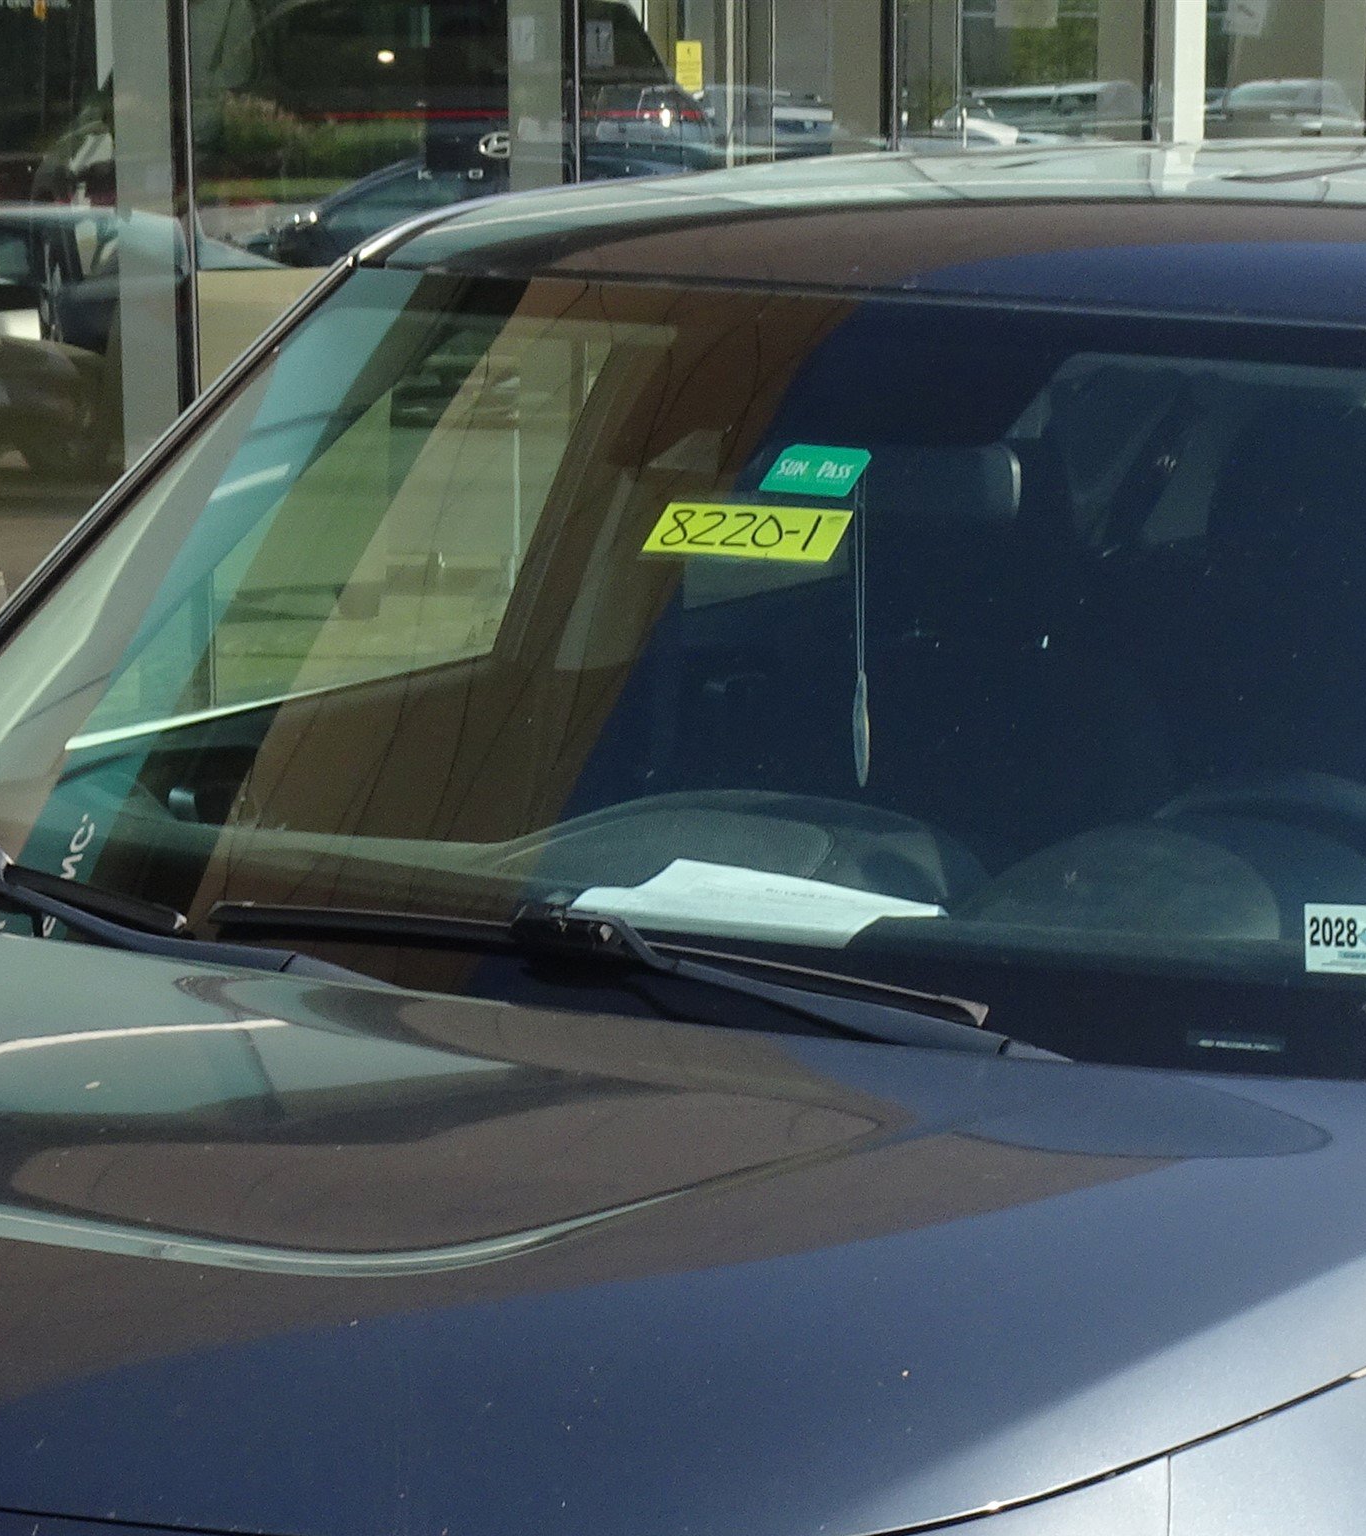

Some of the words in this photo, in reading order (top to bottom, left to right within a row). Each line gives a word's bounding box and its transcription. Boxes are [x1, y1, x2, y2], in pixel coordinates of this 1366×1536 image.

[777, 459, 809, 477] SUN
[660, 509, 823, 552] 8220-1
[1309, 916, 1358, 948] 2028
